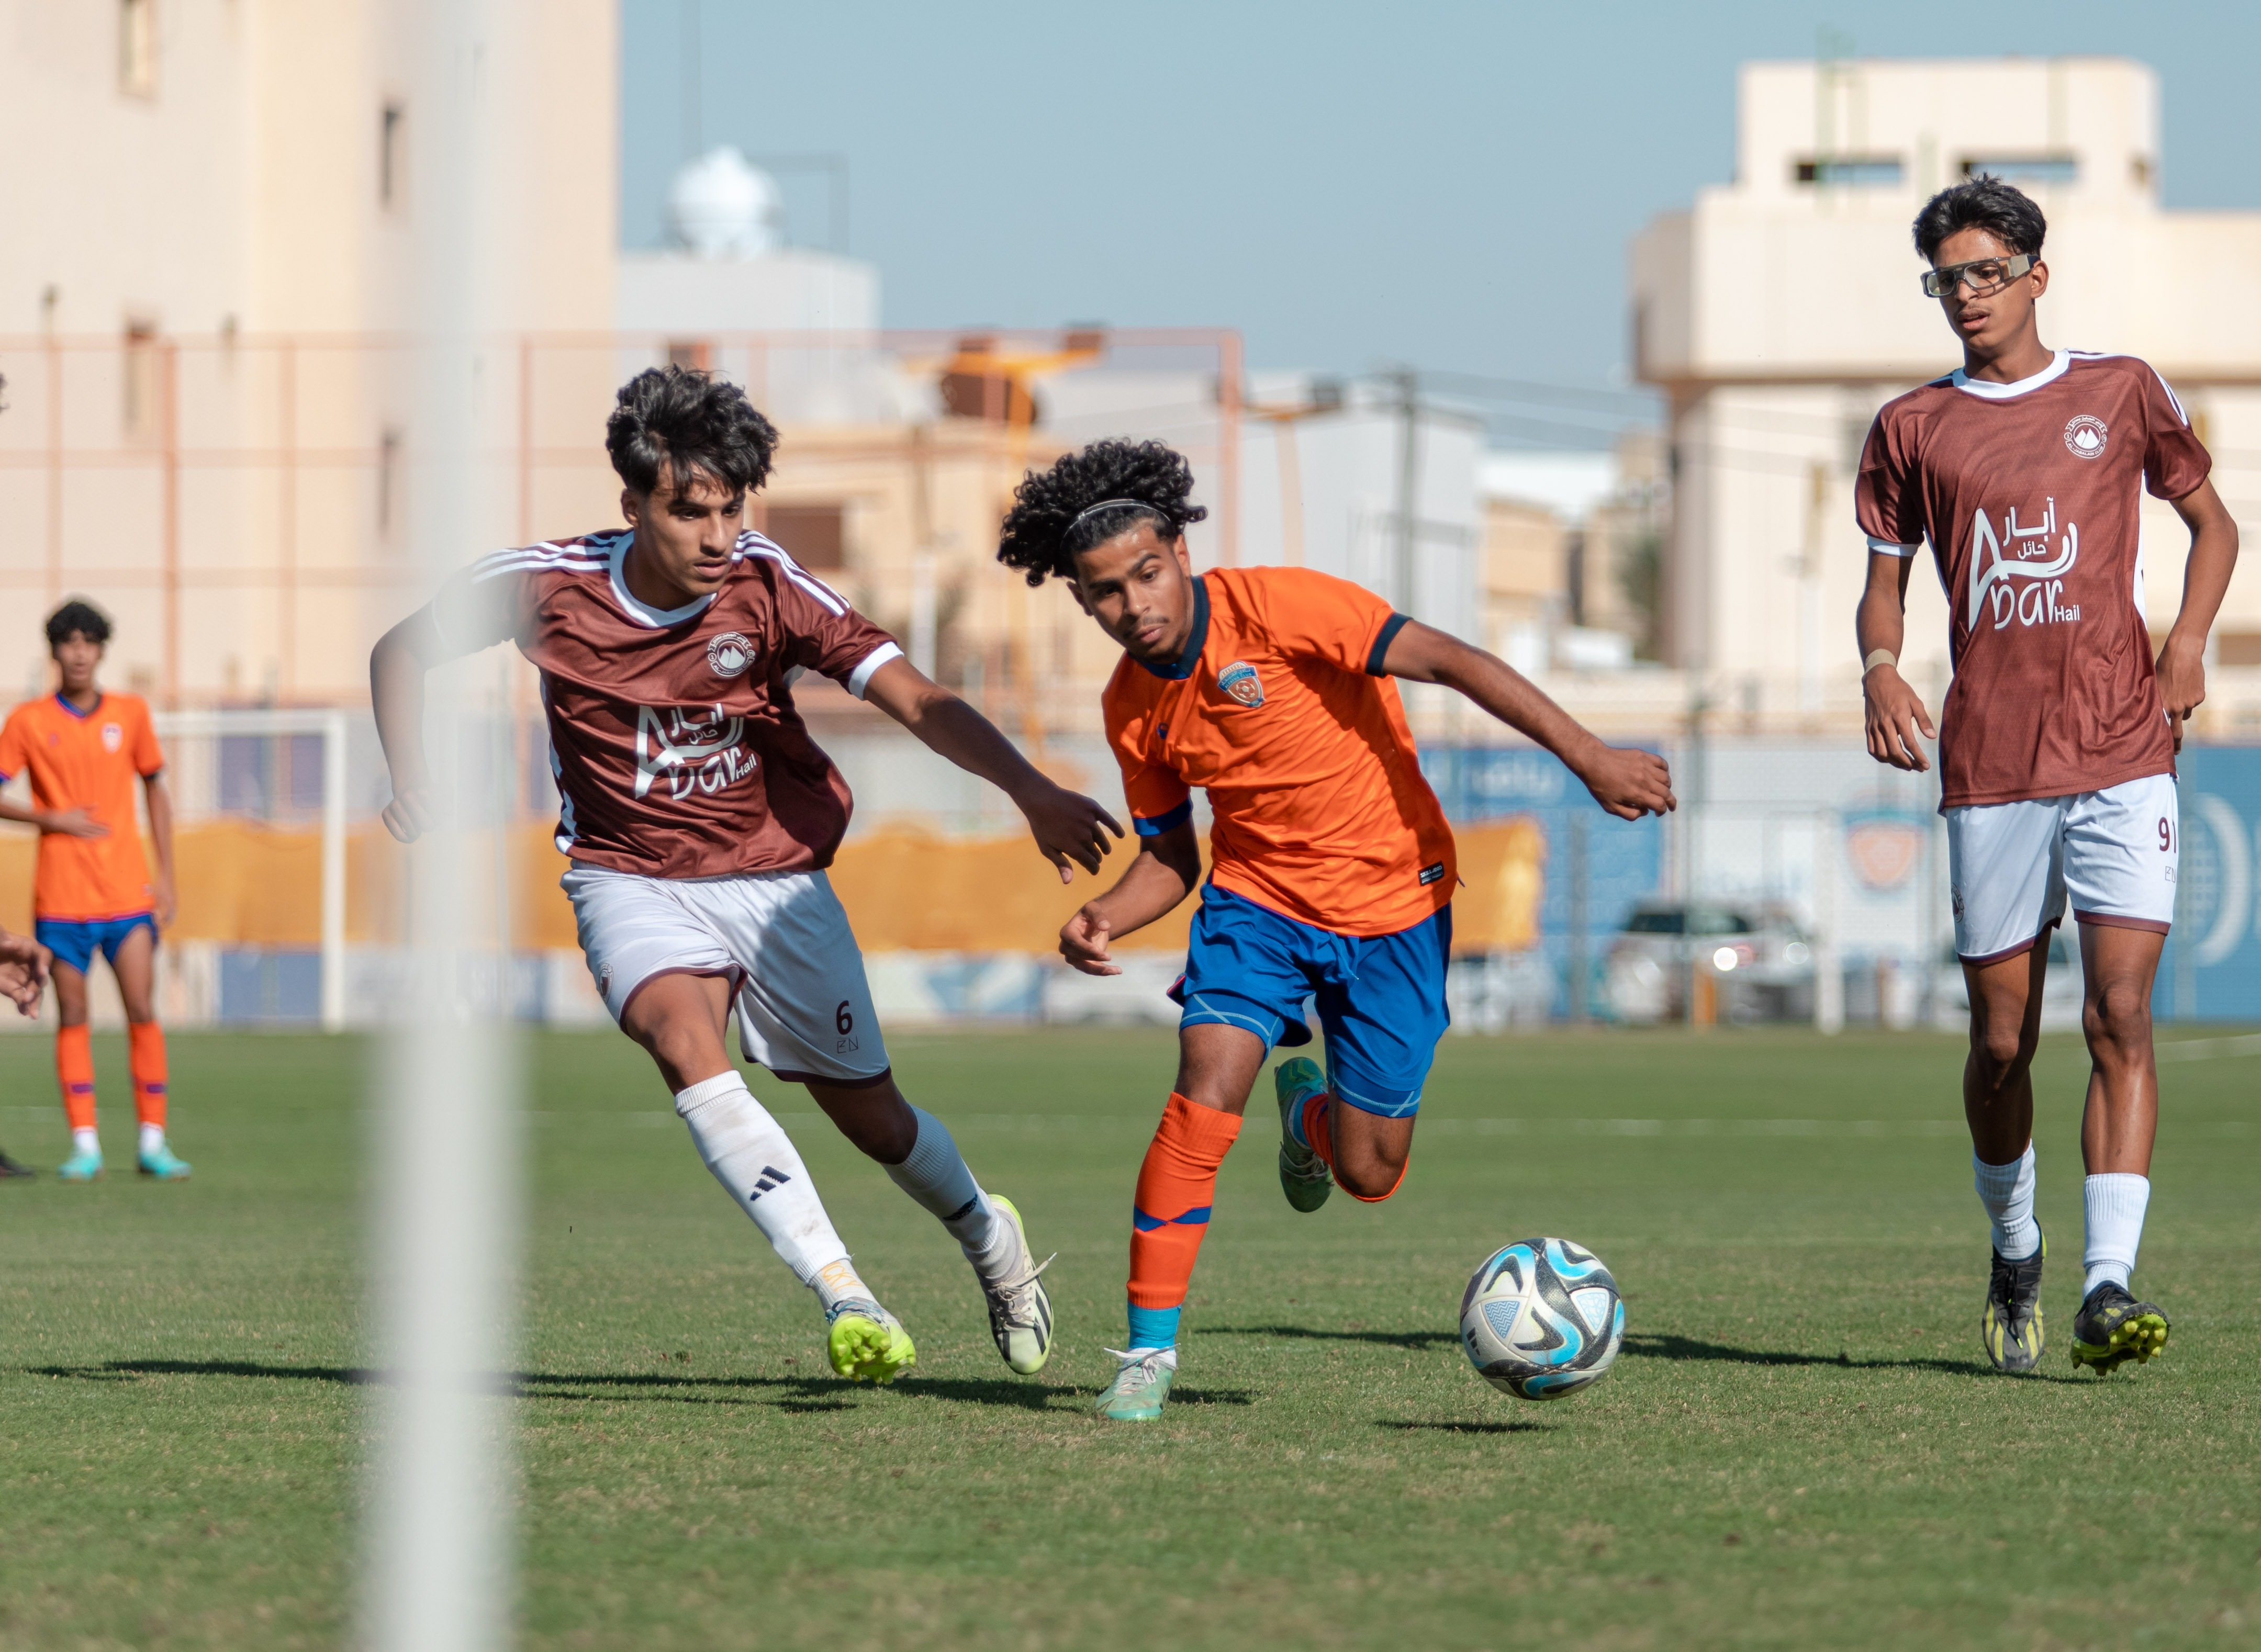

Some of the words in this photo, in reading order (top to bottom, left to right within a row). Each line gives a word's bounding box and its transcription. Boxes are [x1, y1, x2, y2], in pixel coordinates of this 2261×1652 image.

[2003, 496, 2056, 546] آبار
[2018, 541, 2046, 559] حائل
[2054, 604, 2080, 622] Hail
[736, 753, 757, 779] Hail
[836, 1000, 853, 1035] 6
